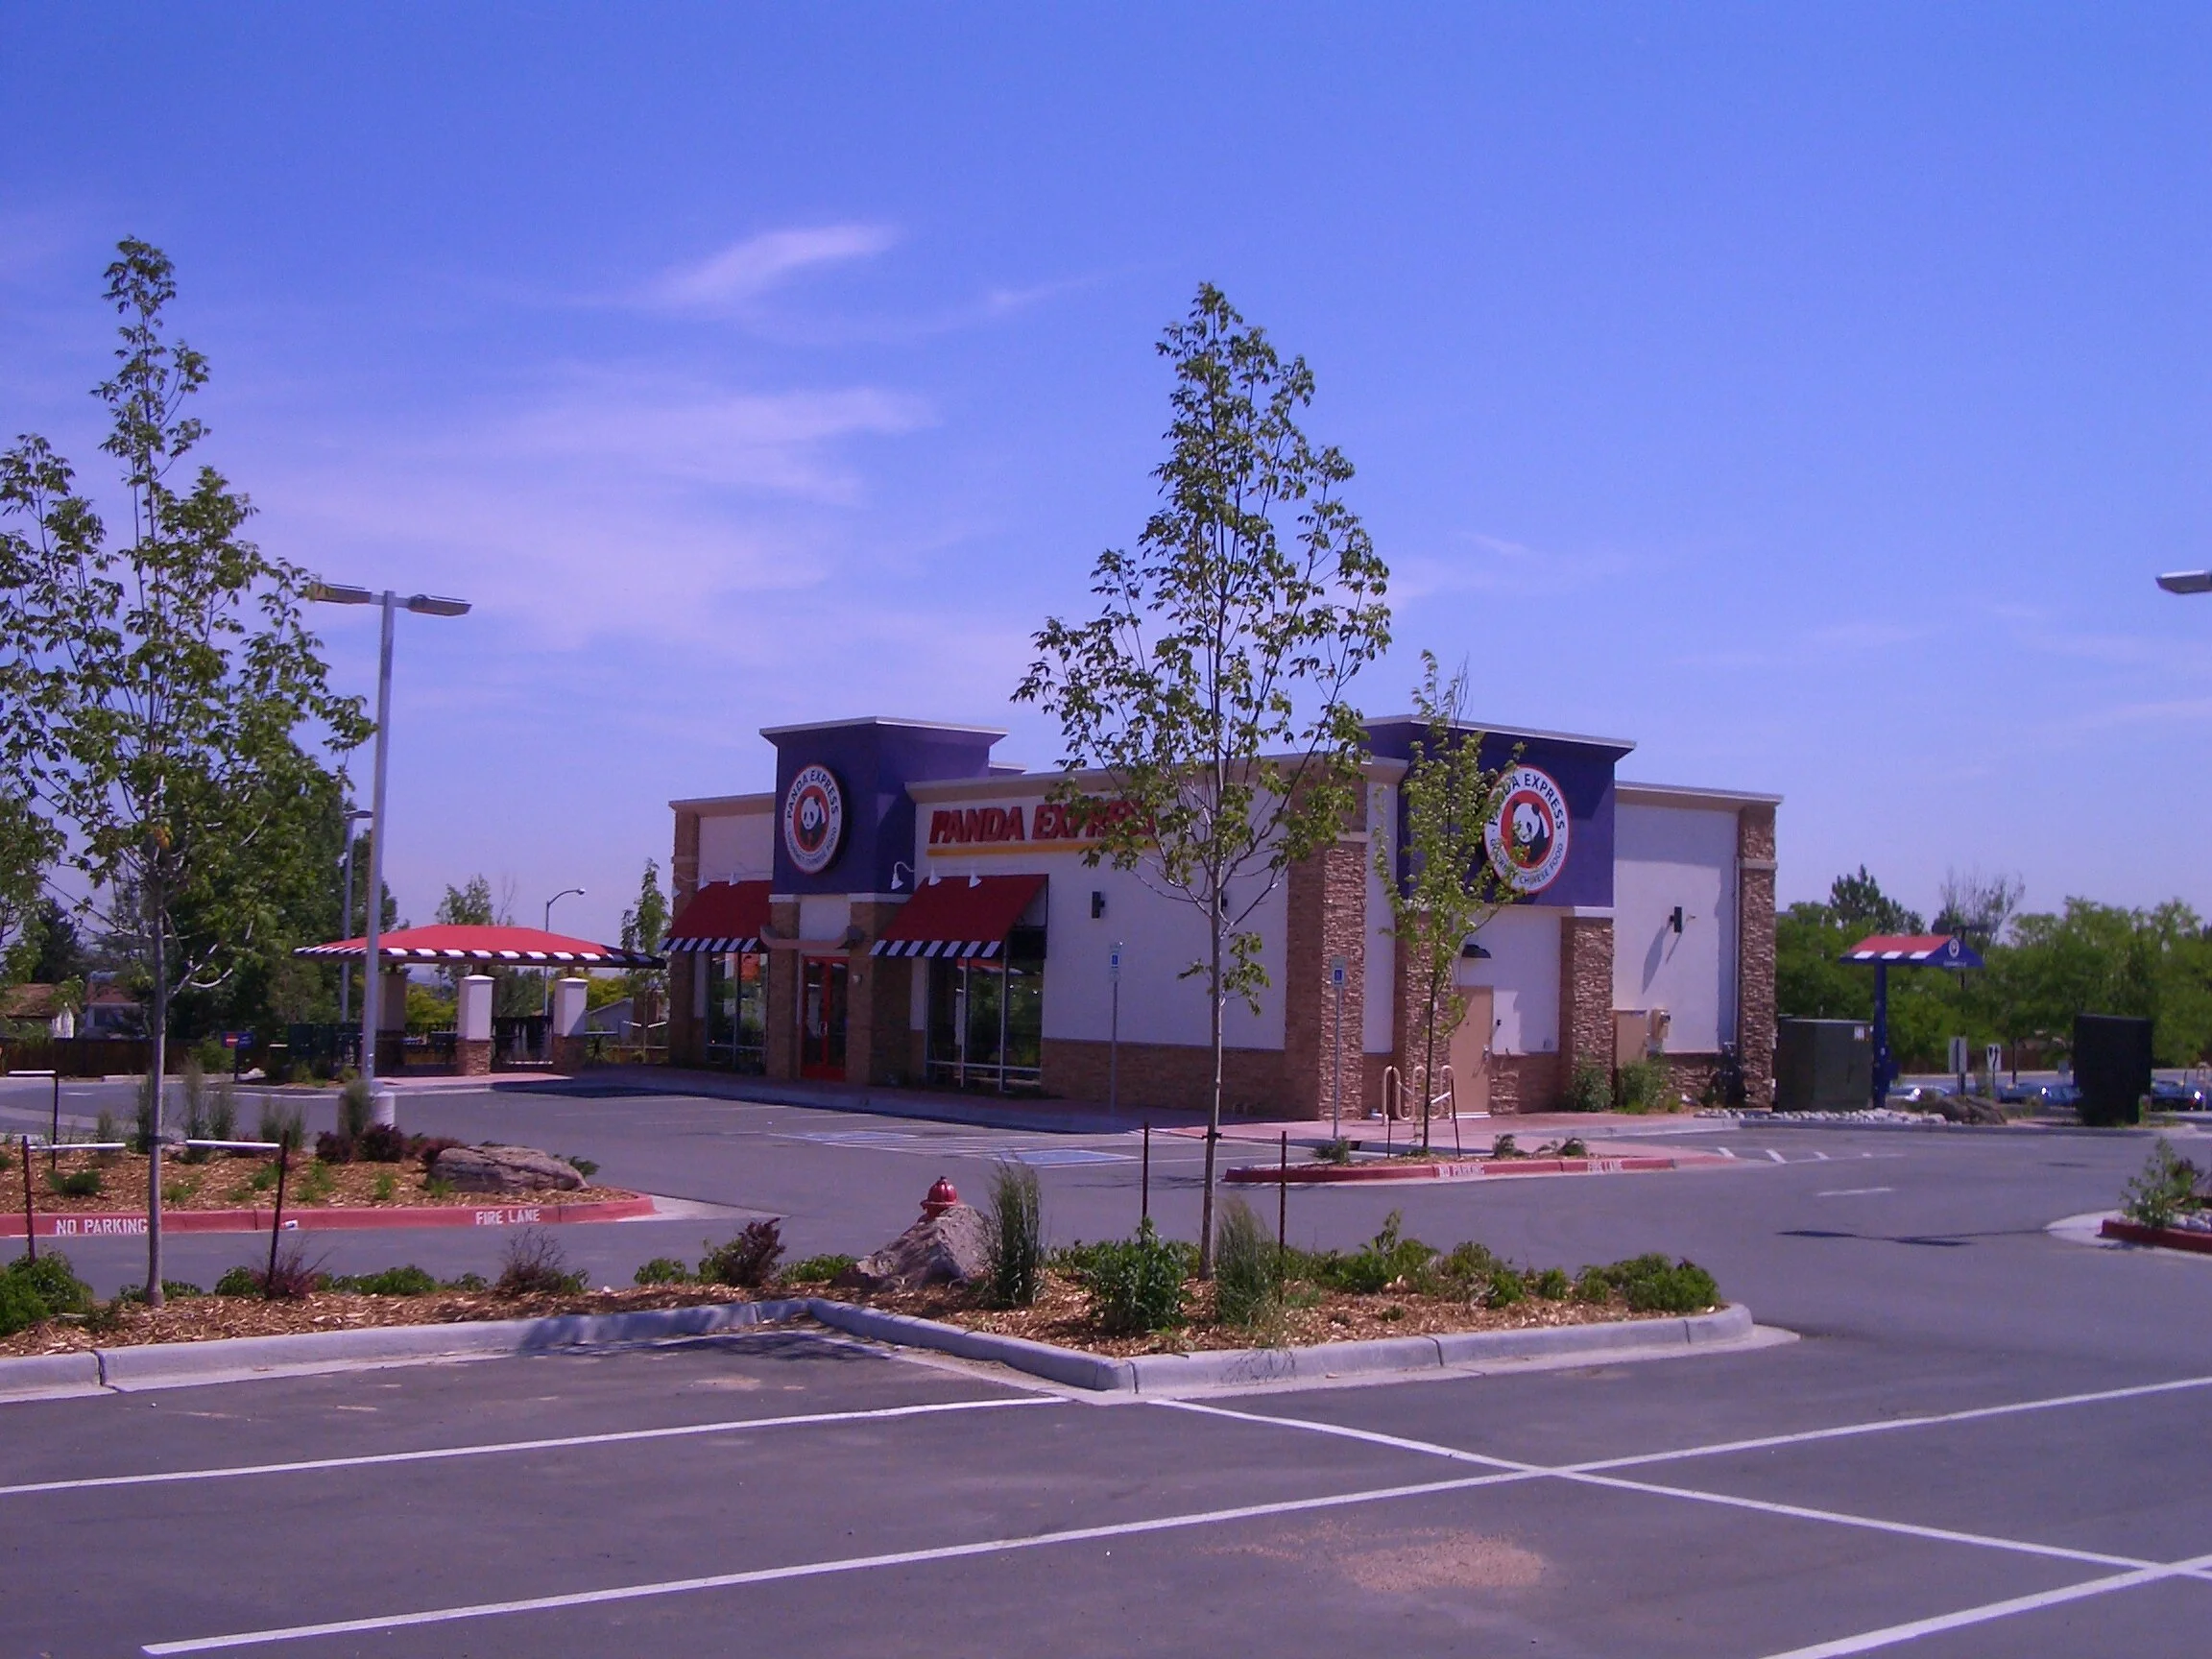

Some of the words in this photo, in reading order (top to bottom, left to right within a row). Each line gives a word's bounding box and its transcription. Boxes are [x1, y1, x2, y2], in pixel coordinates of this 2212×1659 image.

[787, 774, 808, 819] PANDA
[810, 770, 838, 814] EXPRESS
[1489, 776, 1520, 826] PDA
[1524, 774, 1565, 830] EXPRESS
[929, 806, 1024, 843] PANDA
[1520, 868, 1550, 884] CHESE
[1549, 843, 1563, 870] FOOD
[56, 1218, 77, 1236] NO
[84, 1217, 149, 1235] PARKING
[476, 1210, 503, 1225] FIRE
[508, 1209, 541, 1223] LANE
